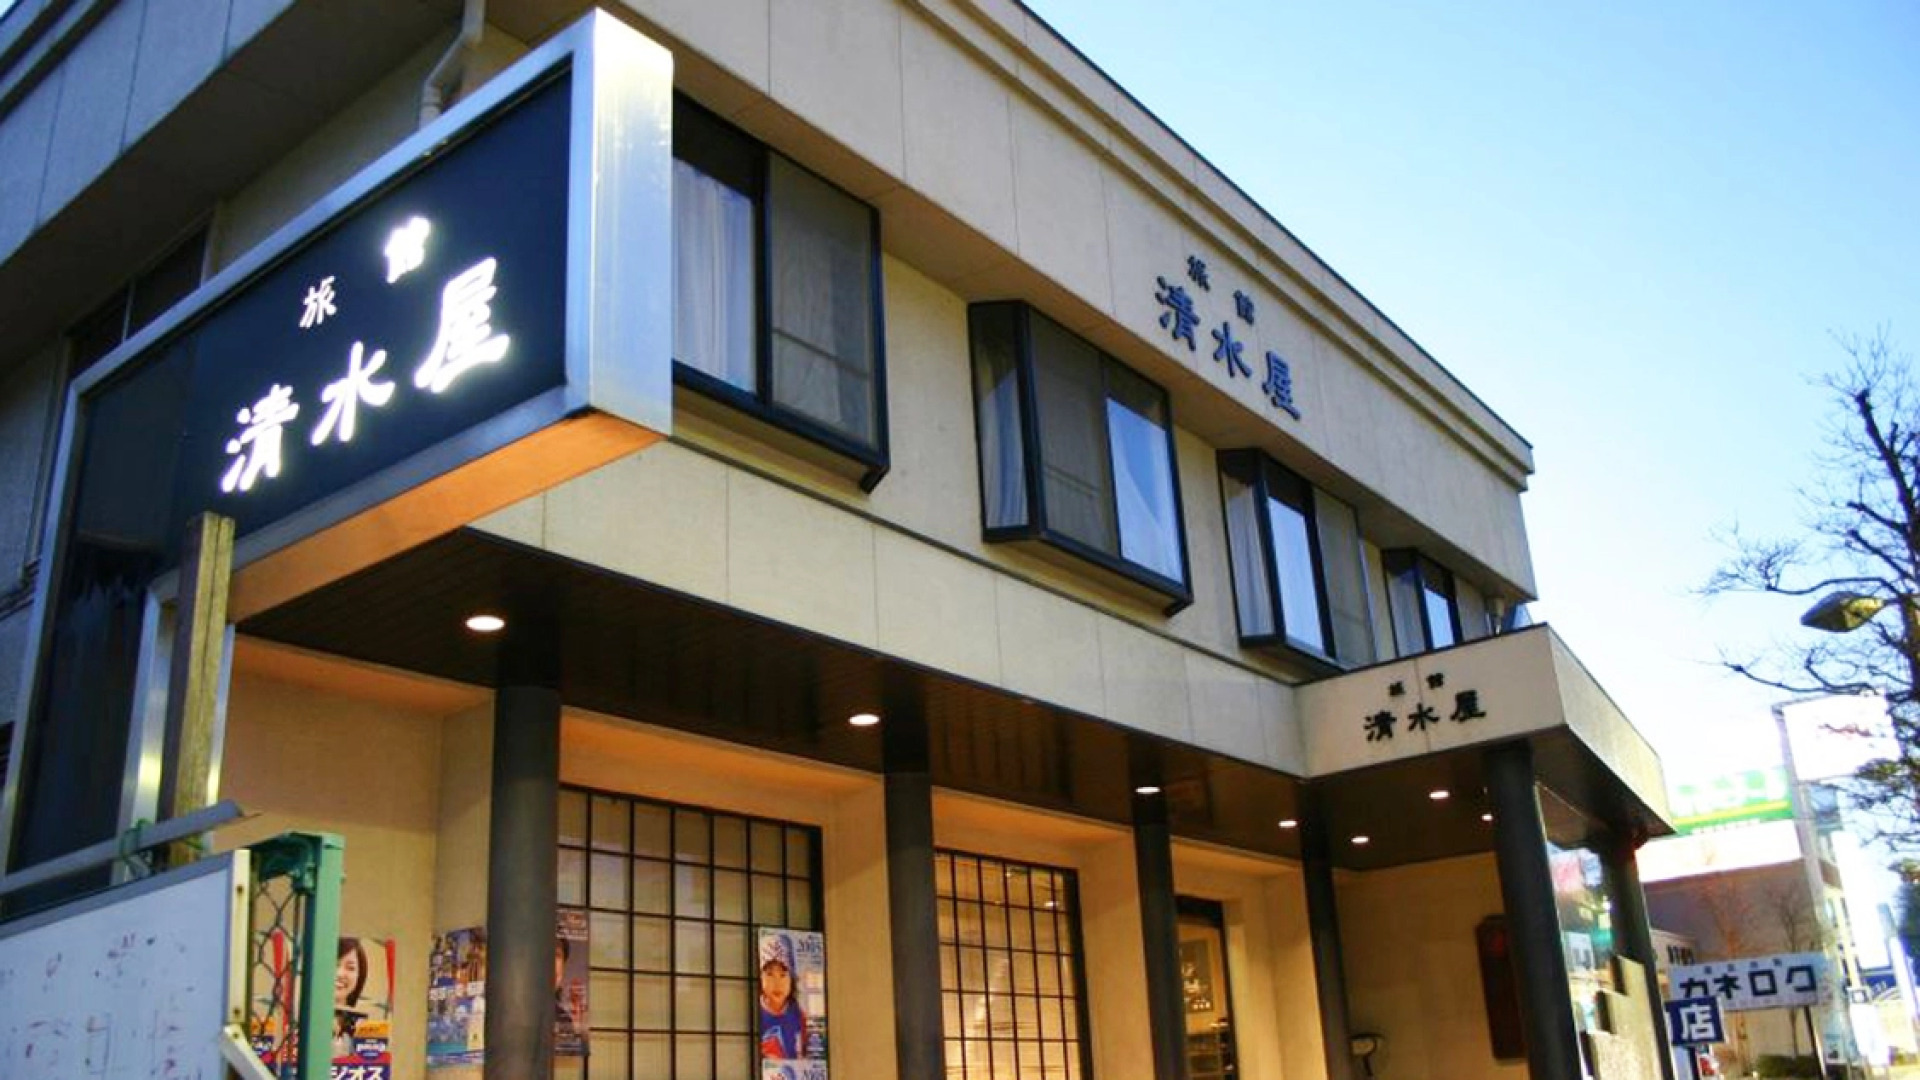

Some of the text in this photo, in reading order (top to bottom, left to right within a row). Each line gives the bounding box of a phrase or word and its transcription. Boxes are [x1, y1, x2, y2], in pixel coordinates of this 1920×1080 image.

[1155, 275, 1301, 421] 清水屋
[221, 256, 511, 492] 清水屋
[1363, 690, 1487, 741] 清水屋
[1679, 965, 1817, 999] カネロク
[1679, 1004, 1716, 1041] 店
